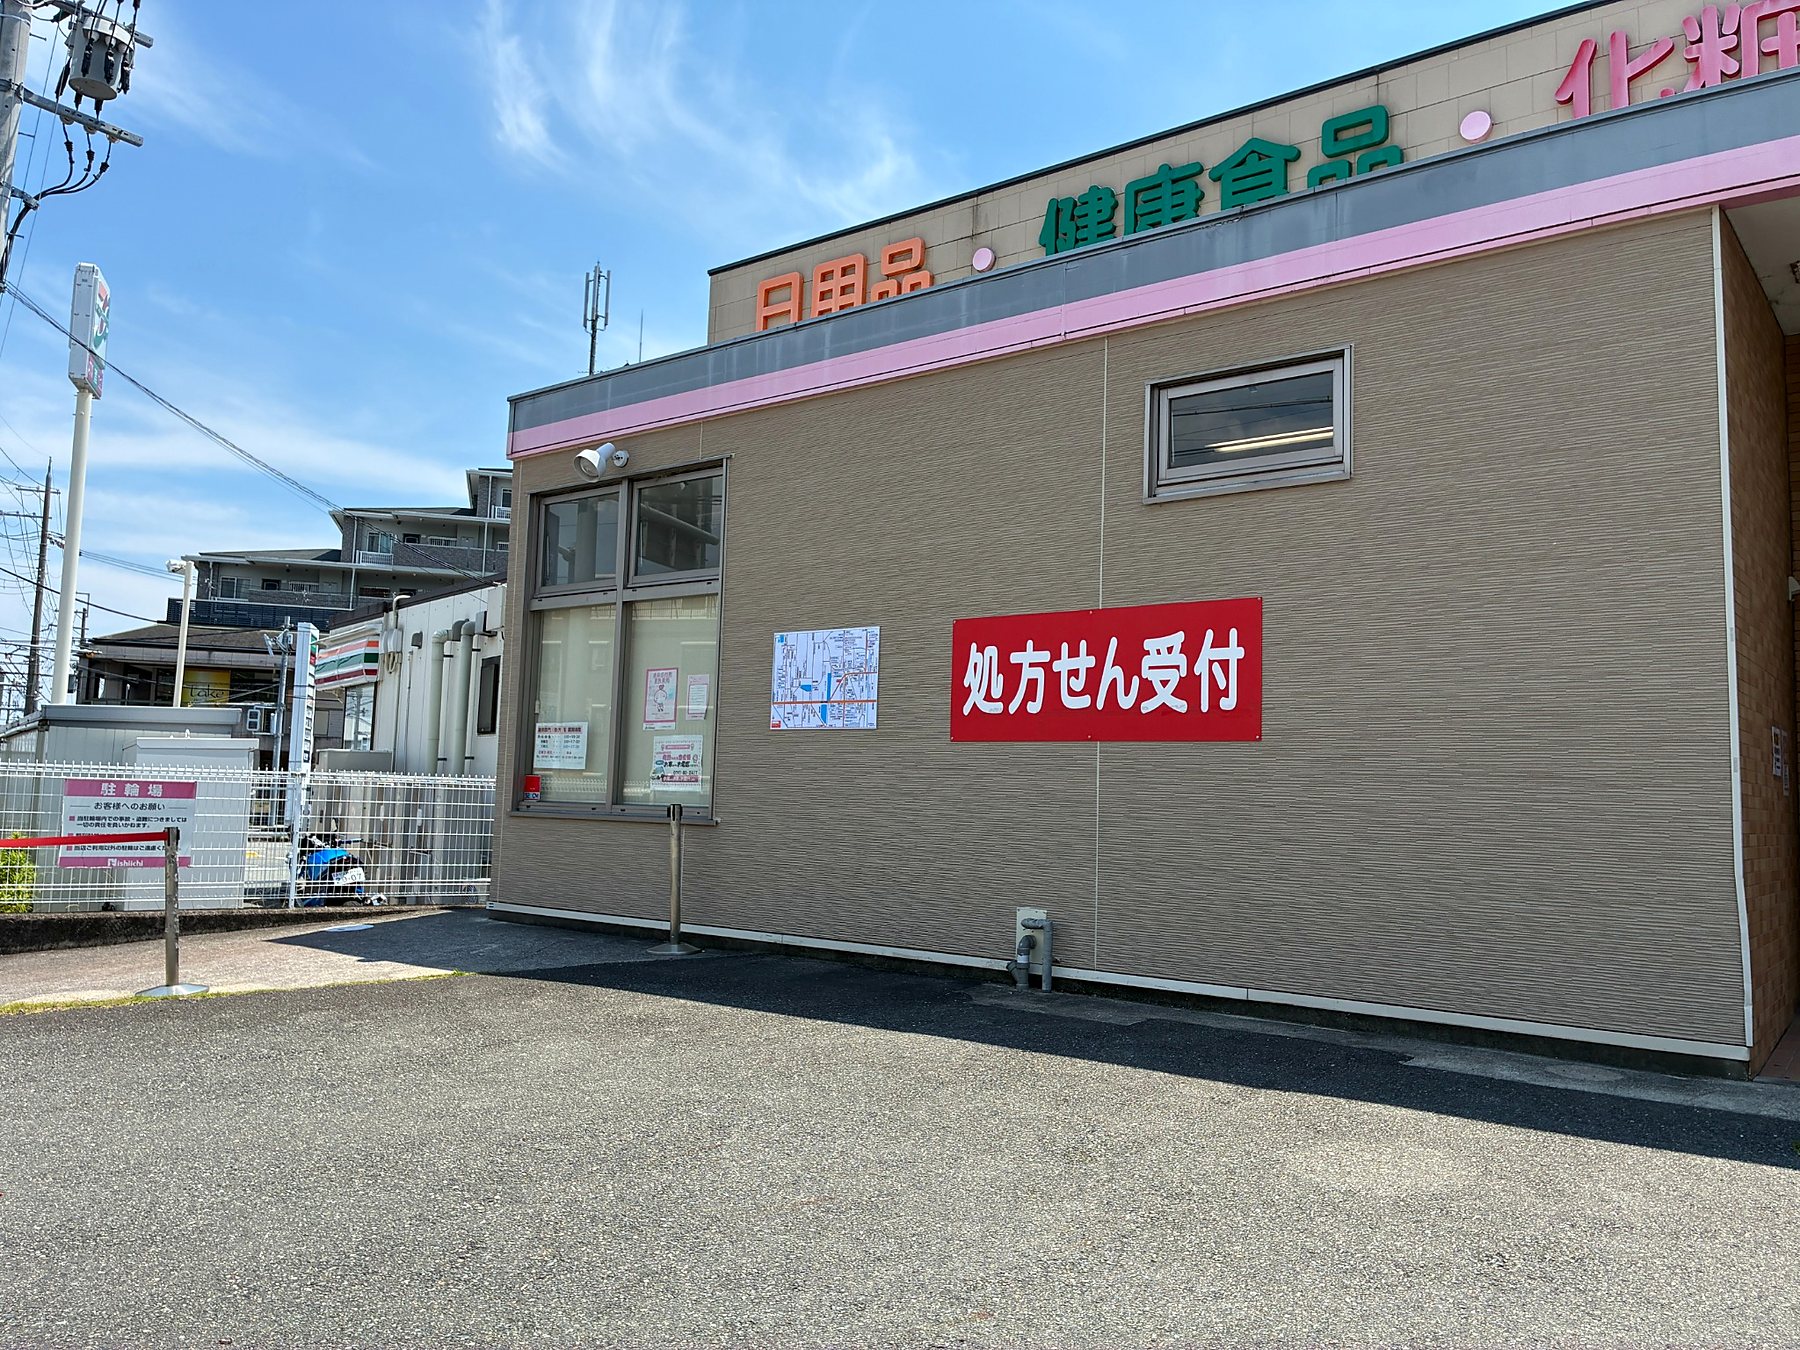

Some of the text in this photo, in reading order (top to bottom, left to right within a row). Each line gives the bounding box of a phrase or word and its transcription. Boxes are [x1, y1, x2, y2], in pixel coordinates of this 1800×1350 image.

[1037, 105, 1404, 256] 健康食品
[755, 237, 933, 332] 日用品
[962, 627, 1246, 717] 処方せん受付
[94, 802, 166, 811] お客様へのお願い
[100, 783, 163, 797] 駐輪場
